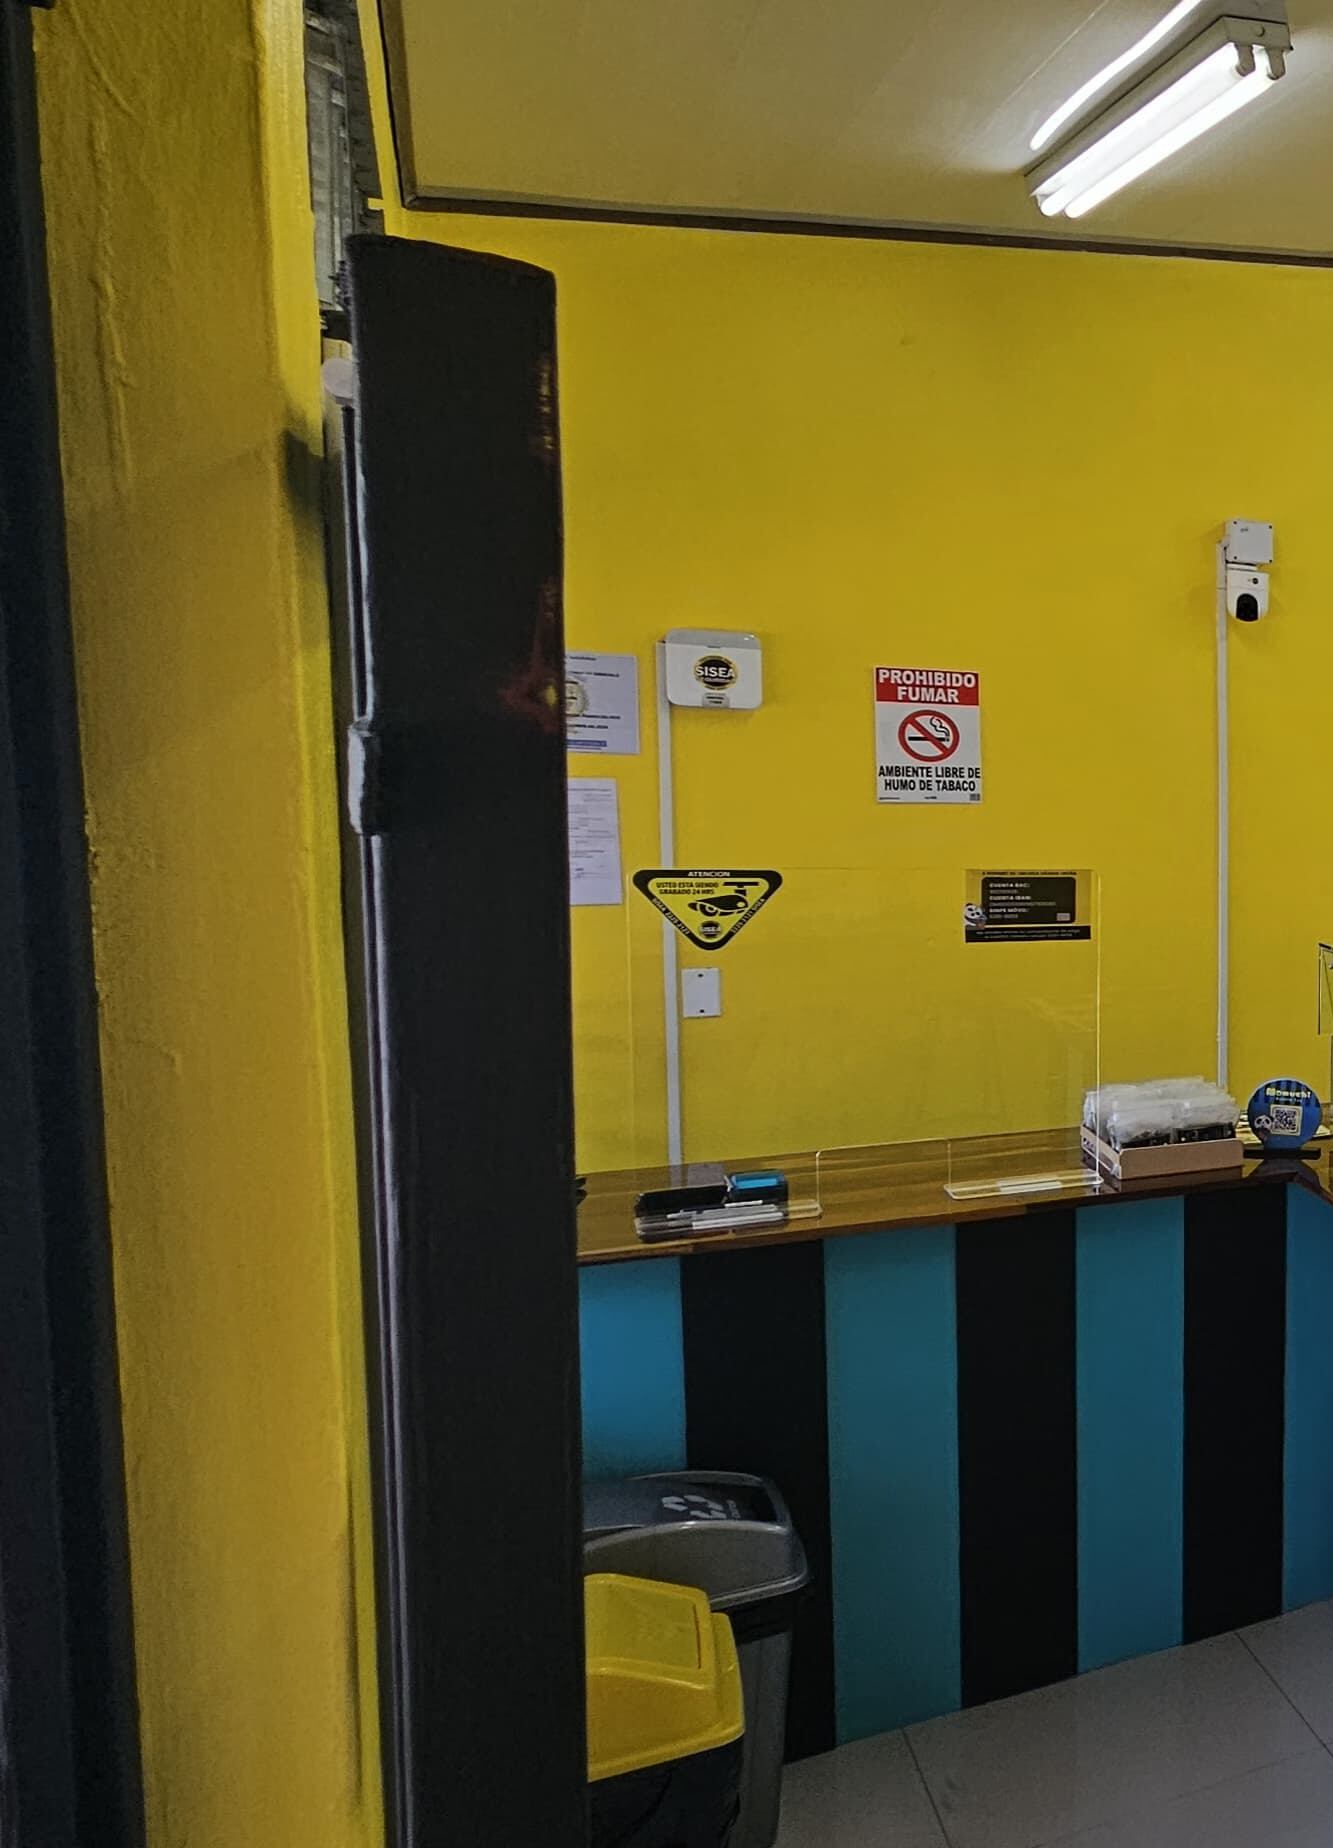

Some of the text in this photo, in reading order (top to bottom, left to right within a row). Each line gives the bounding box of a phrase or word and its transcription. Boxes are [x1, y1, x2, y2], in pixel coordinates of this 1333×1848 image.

[696, 665, 736, 679] SISEA
[878, 669, 976, 688] PROHIBIDO
[897, 686, 960, 704] FUMAR
[878, 765, 981, 779] AMBIENTE LIBRE DE
[884, 779, 976, 792] HUMO DE TABACO
